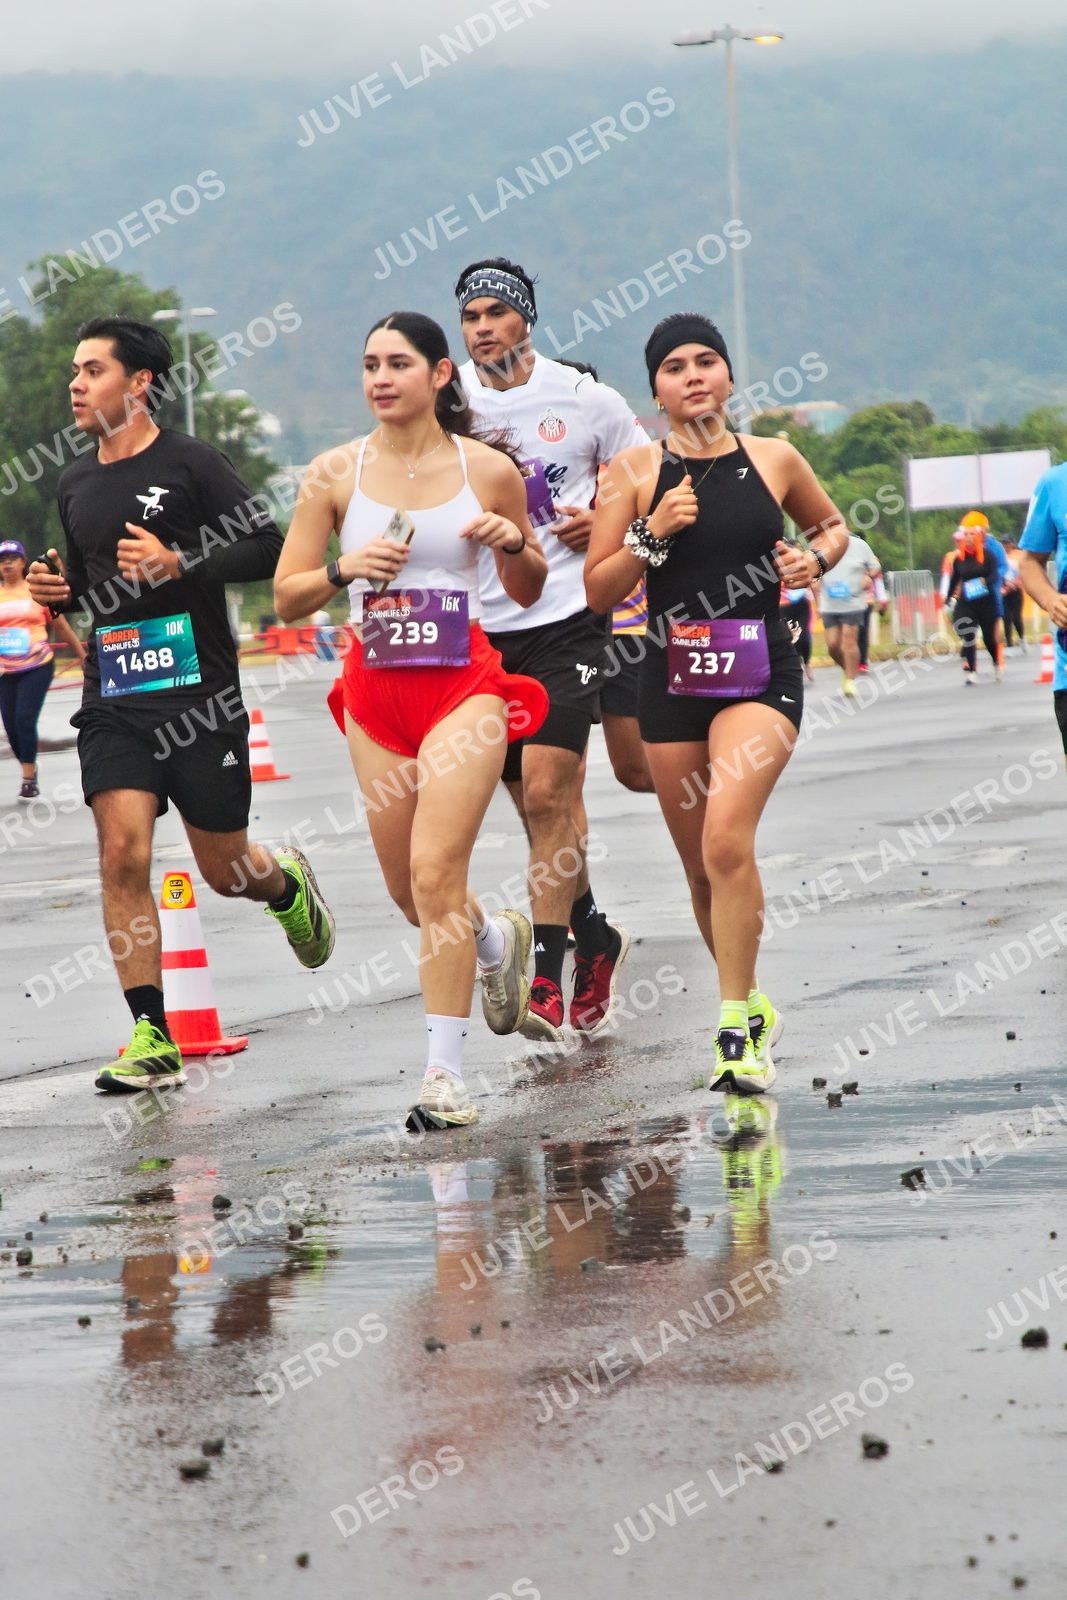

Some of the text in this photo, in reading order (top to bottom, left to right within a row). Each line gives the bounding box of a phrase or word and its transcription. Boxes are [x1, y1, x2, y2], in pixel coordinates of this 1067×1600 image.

[441, 595, 460, 612] 16K
[102, 628, 139, 644] CARRERA
[165, 620, 184, 636] 10K
[389, 621, 438, 645] 239
[739, 625, 759, 641] 16K
[116, 647, 174, 674] 1488
[688, 652, 736, 675] 237
